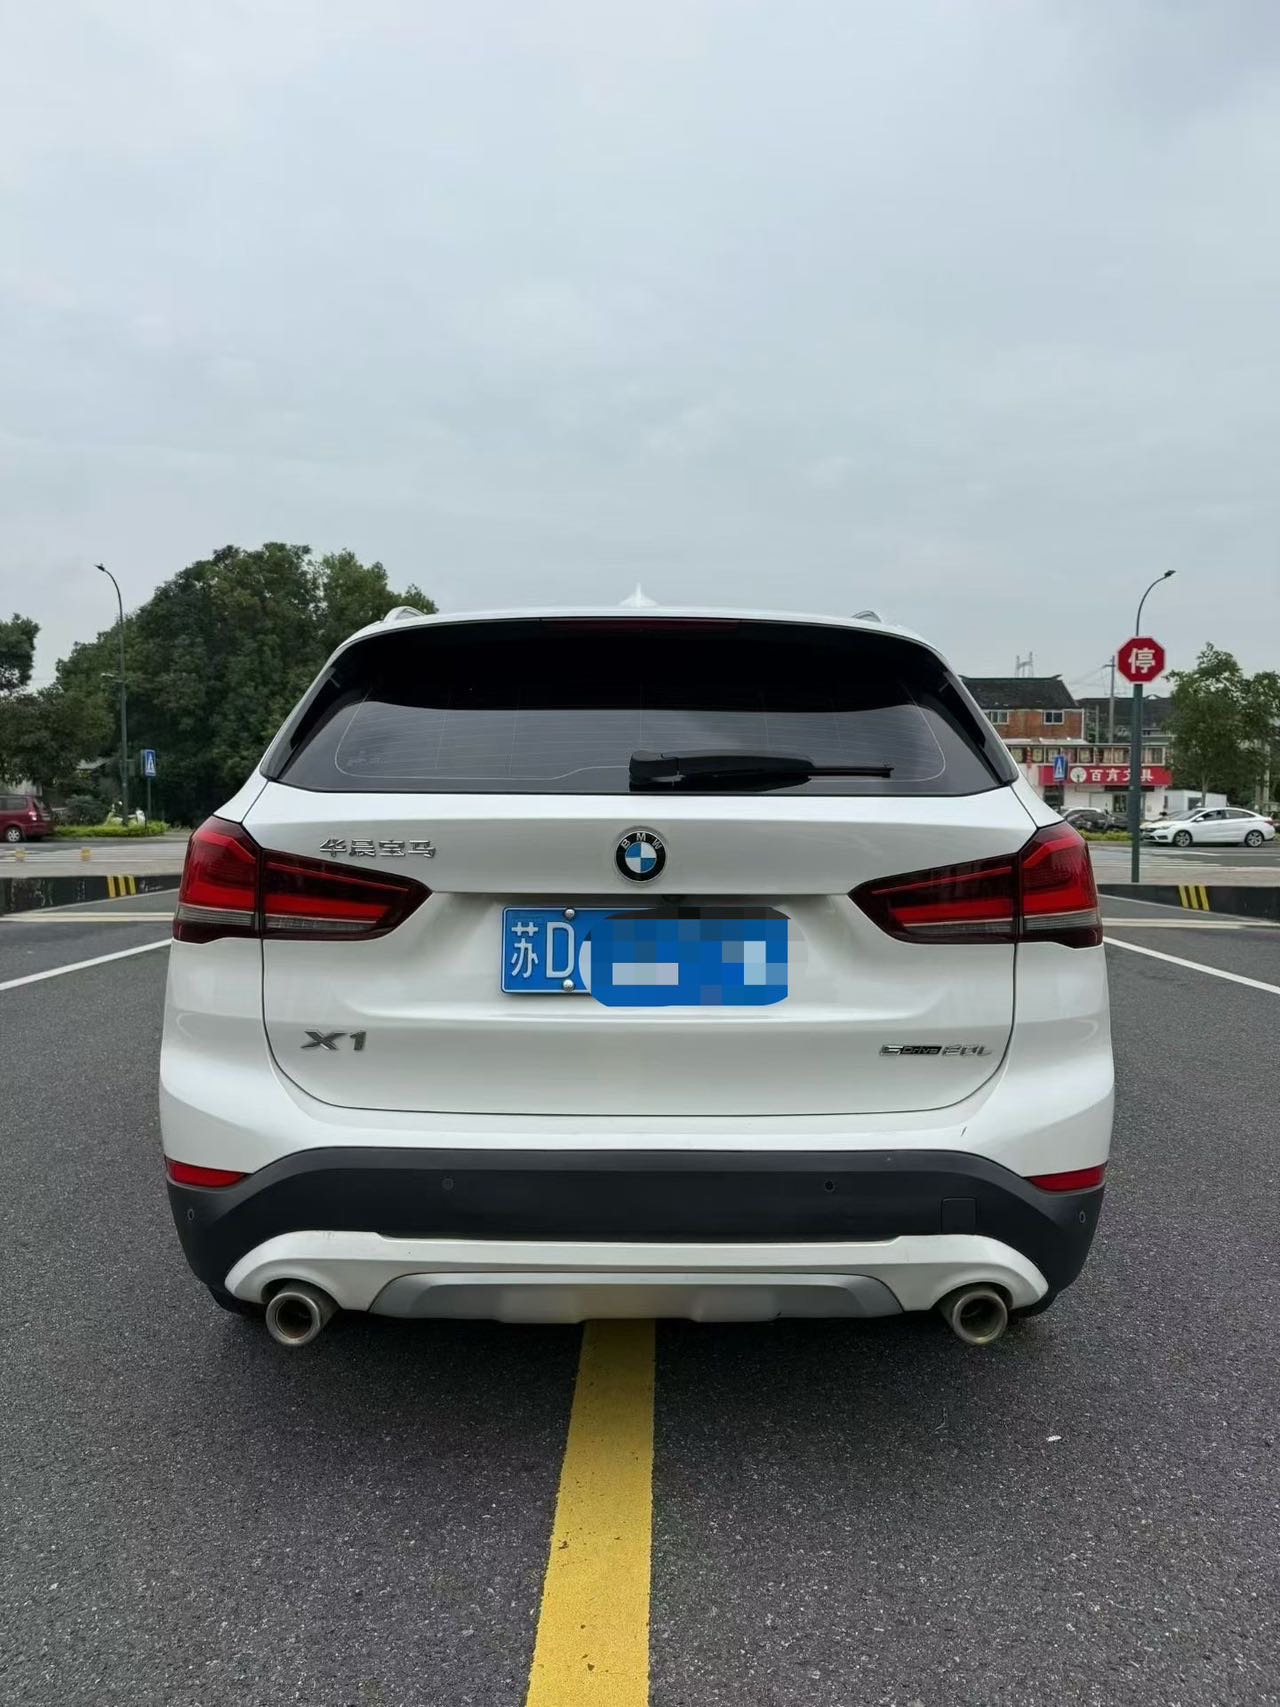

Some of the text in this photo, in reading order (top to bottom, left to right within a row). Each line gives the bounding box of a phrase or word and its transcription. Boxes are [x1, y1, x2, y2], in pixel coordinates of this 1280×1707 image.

[1128, 647, 1156, 674] 停
[319, 838, 436, 858] 华晨宝马
[620, 832, 663, 850] BMW
[300, 1031, 367, 1051] X1
